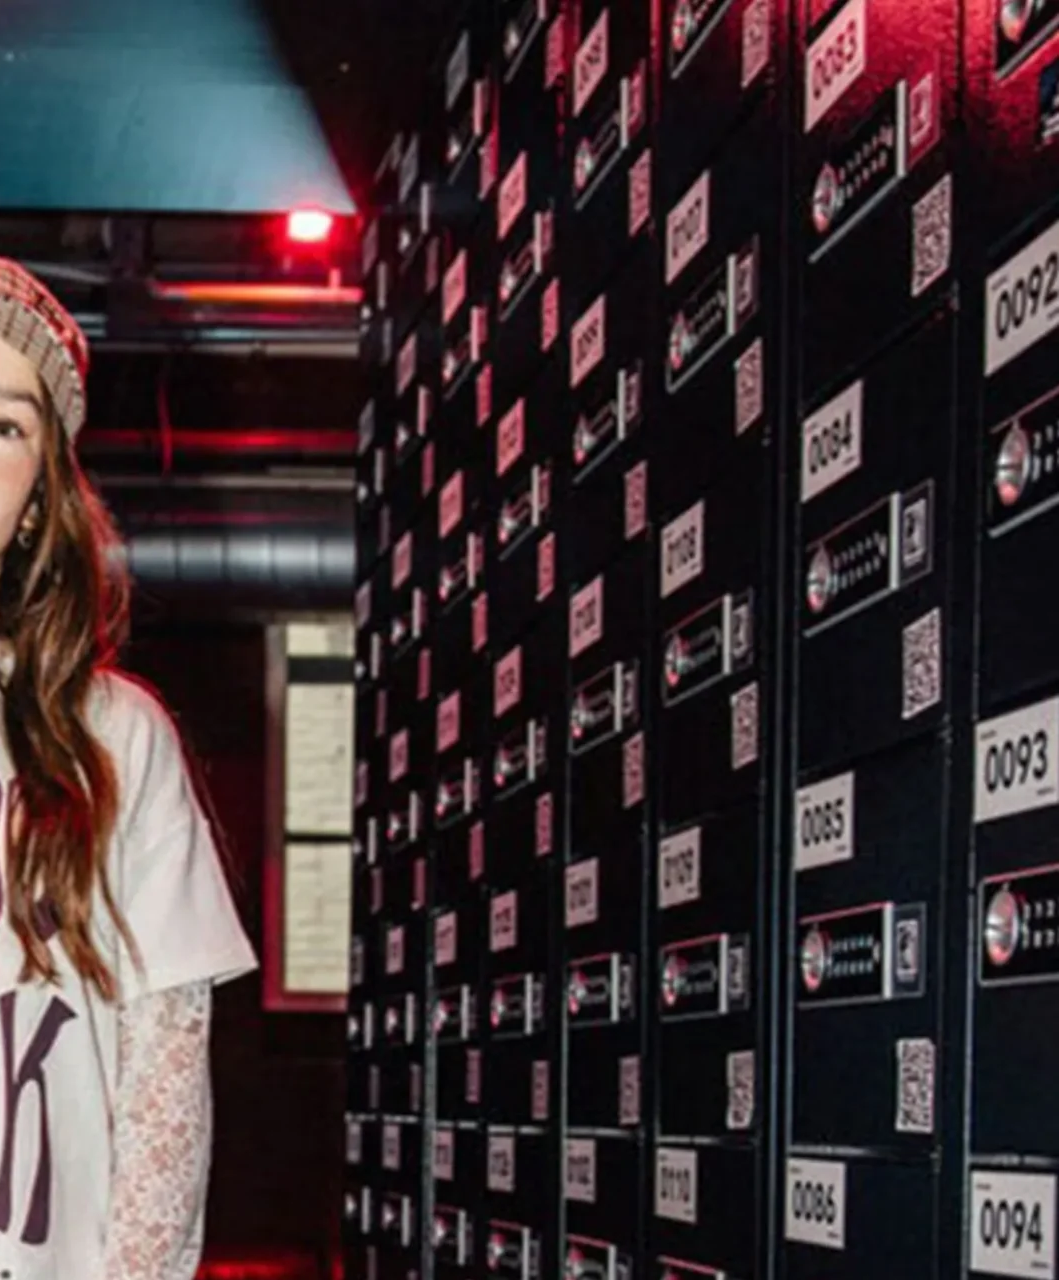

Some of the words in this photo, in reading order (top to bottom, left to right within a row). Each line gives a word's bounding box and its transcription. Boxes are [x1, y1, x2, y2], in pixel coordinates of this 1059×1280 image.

[996, 253, 1059, 339] 0092
[810, 411, 852, 474] 0084
[985, 730, 1047, 793] 0093
[802, 798, 844, 847] 0085
[660, 1166, 692, 1204] 0110
[793, 1181, 835, 1224] 0086
[981, 1199, 1042, 1251] 0094
